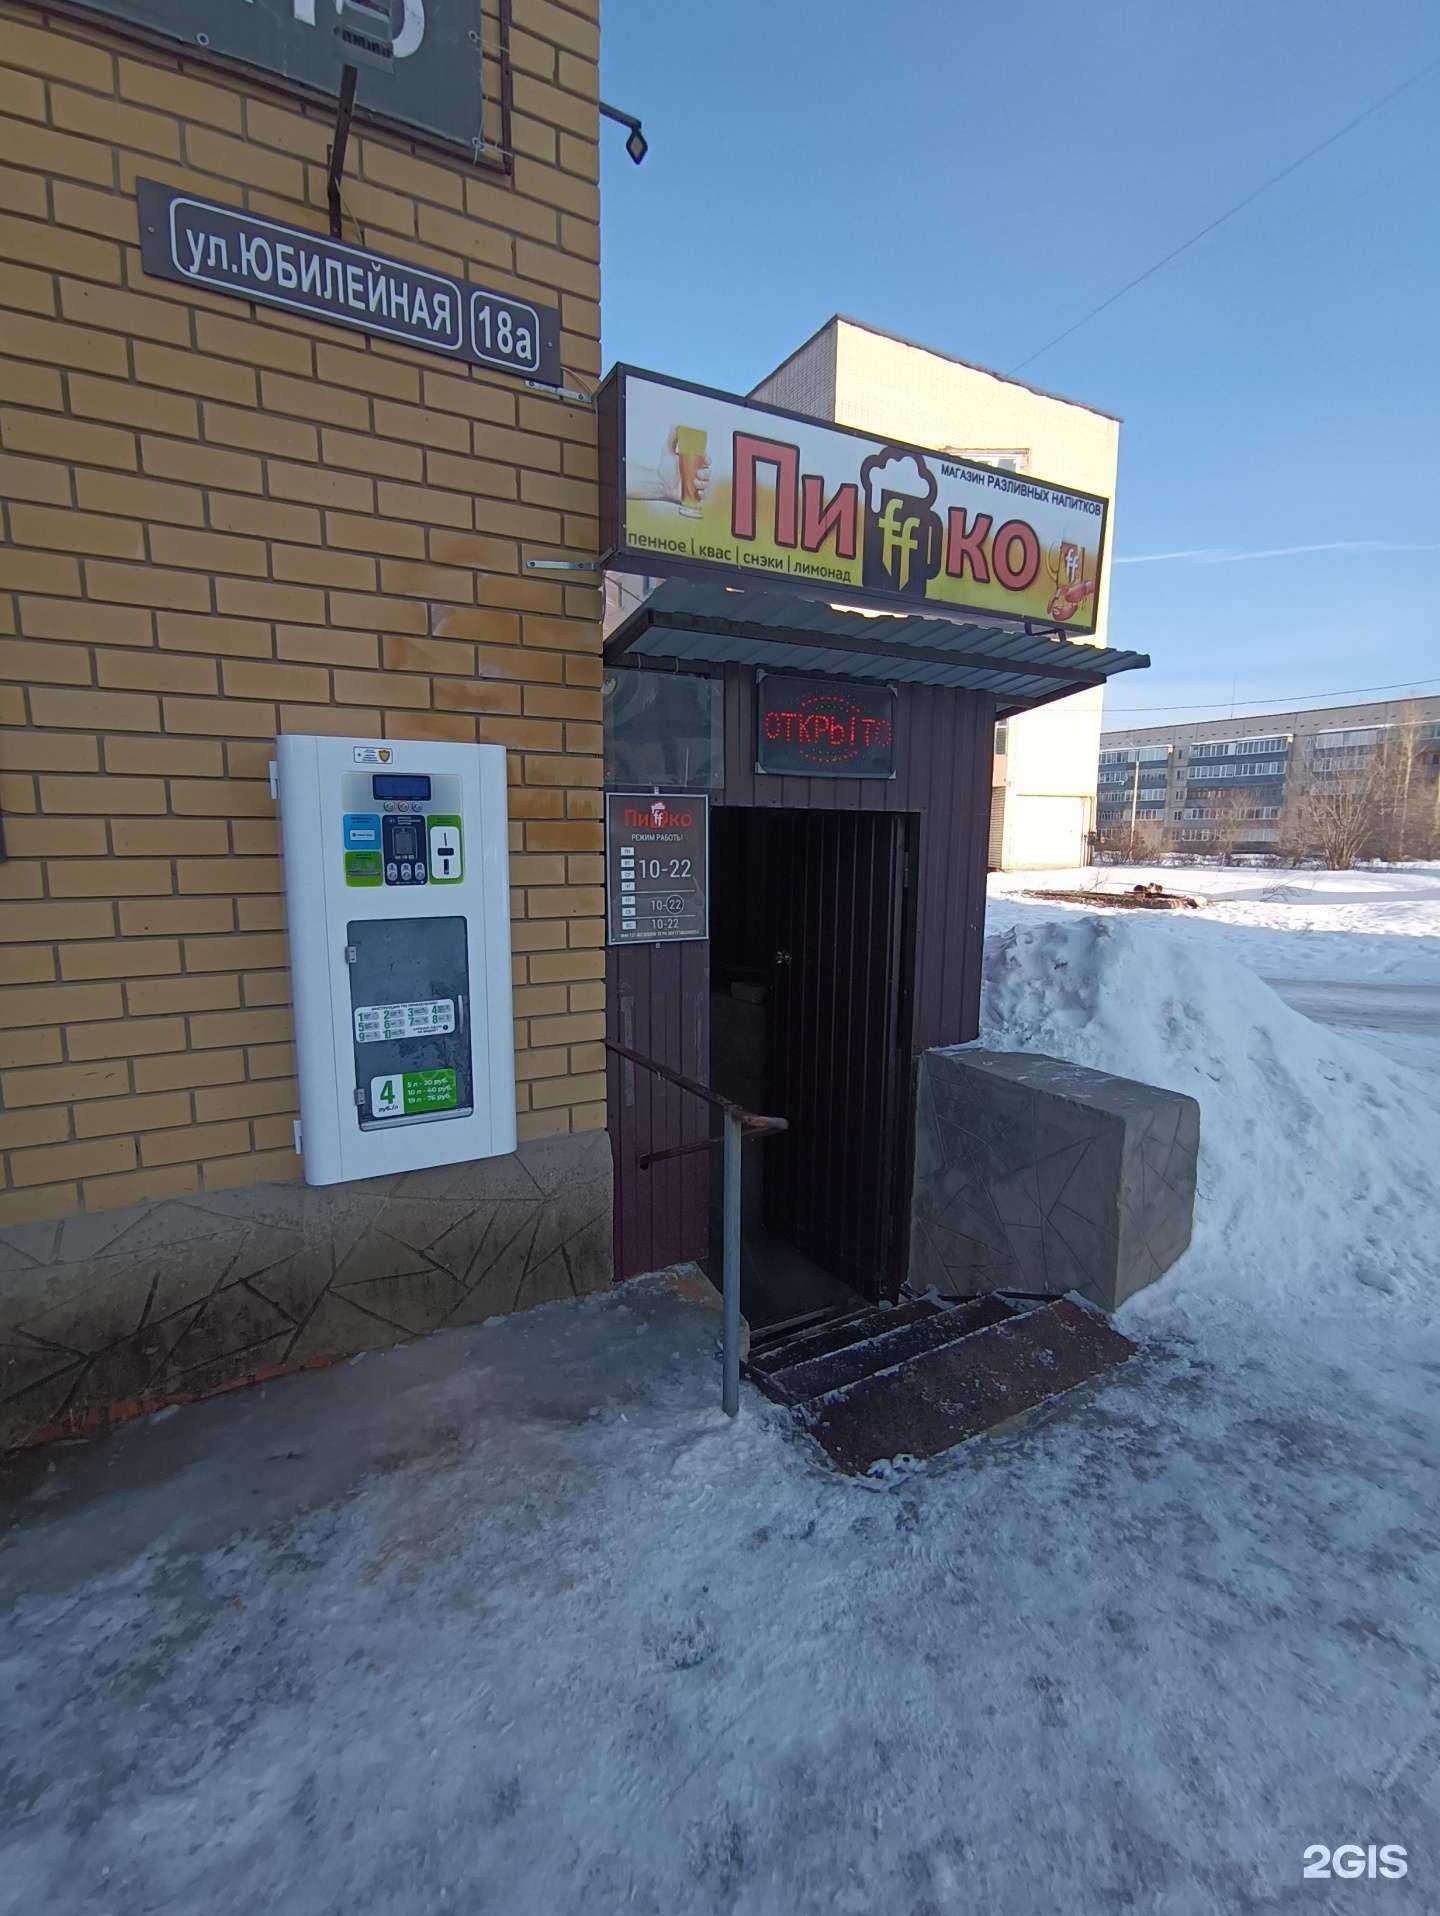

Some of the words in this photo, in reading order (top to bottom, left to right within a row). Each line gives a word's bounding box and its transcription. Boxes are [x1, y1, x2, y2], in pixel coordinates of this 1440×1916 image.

[186, 228, 451, 335] ул.ЮБИЛЕЙНАЯ
[478, 305, 532, 361] 18а
[941, 463, 985, 485] МАГАЗИН
[987, 474, 1050, 502] РАЗЛИВНЫХ
[1051, 491, 1101, 516] НАПИТКОВ
[628, 532, 686, 553] пенное
[699, 545, 732, 562] квас
[743, 552, 783, 570] снэки
[793, 561, 852, 583] лимонад
[631, 833, 655, 842] РЕЖИМ
[639, 859, 691, 879] 10-22
[652, 918, 680, 930] 10-22
[384, 1010, 390, 1020] 2
[408, 1008, 414, 1017] 3
[431, 1006, 437, 1015] 4
[408, 1018, 414, 1027] 7
[380, 1080, 395, 1104] 4
